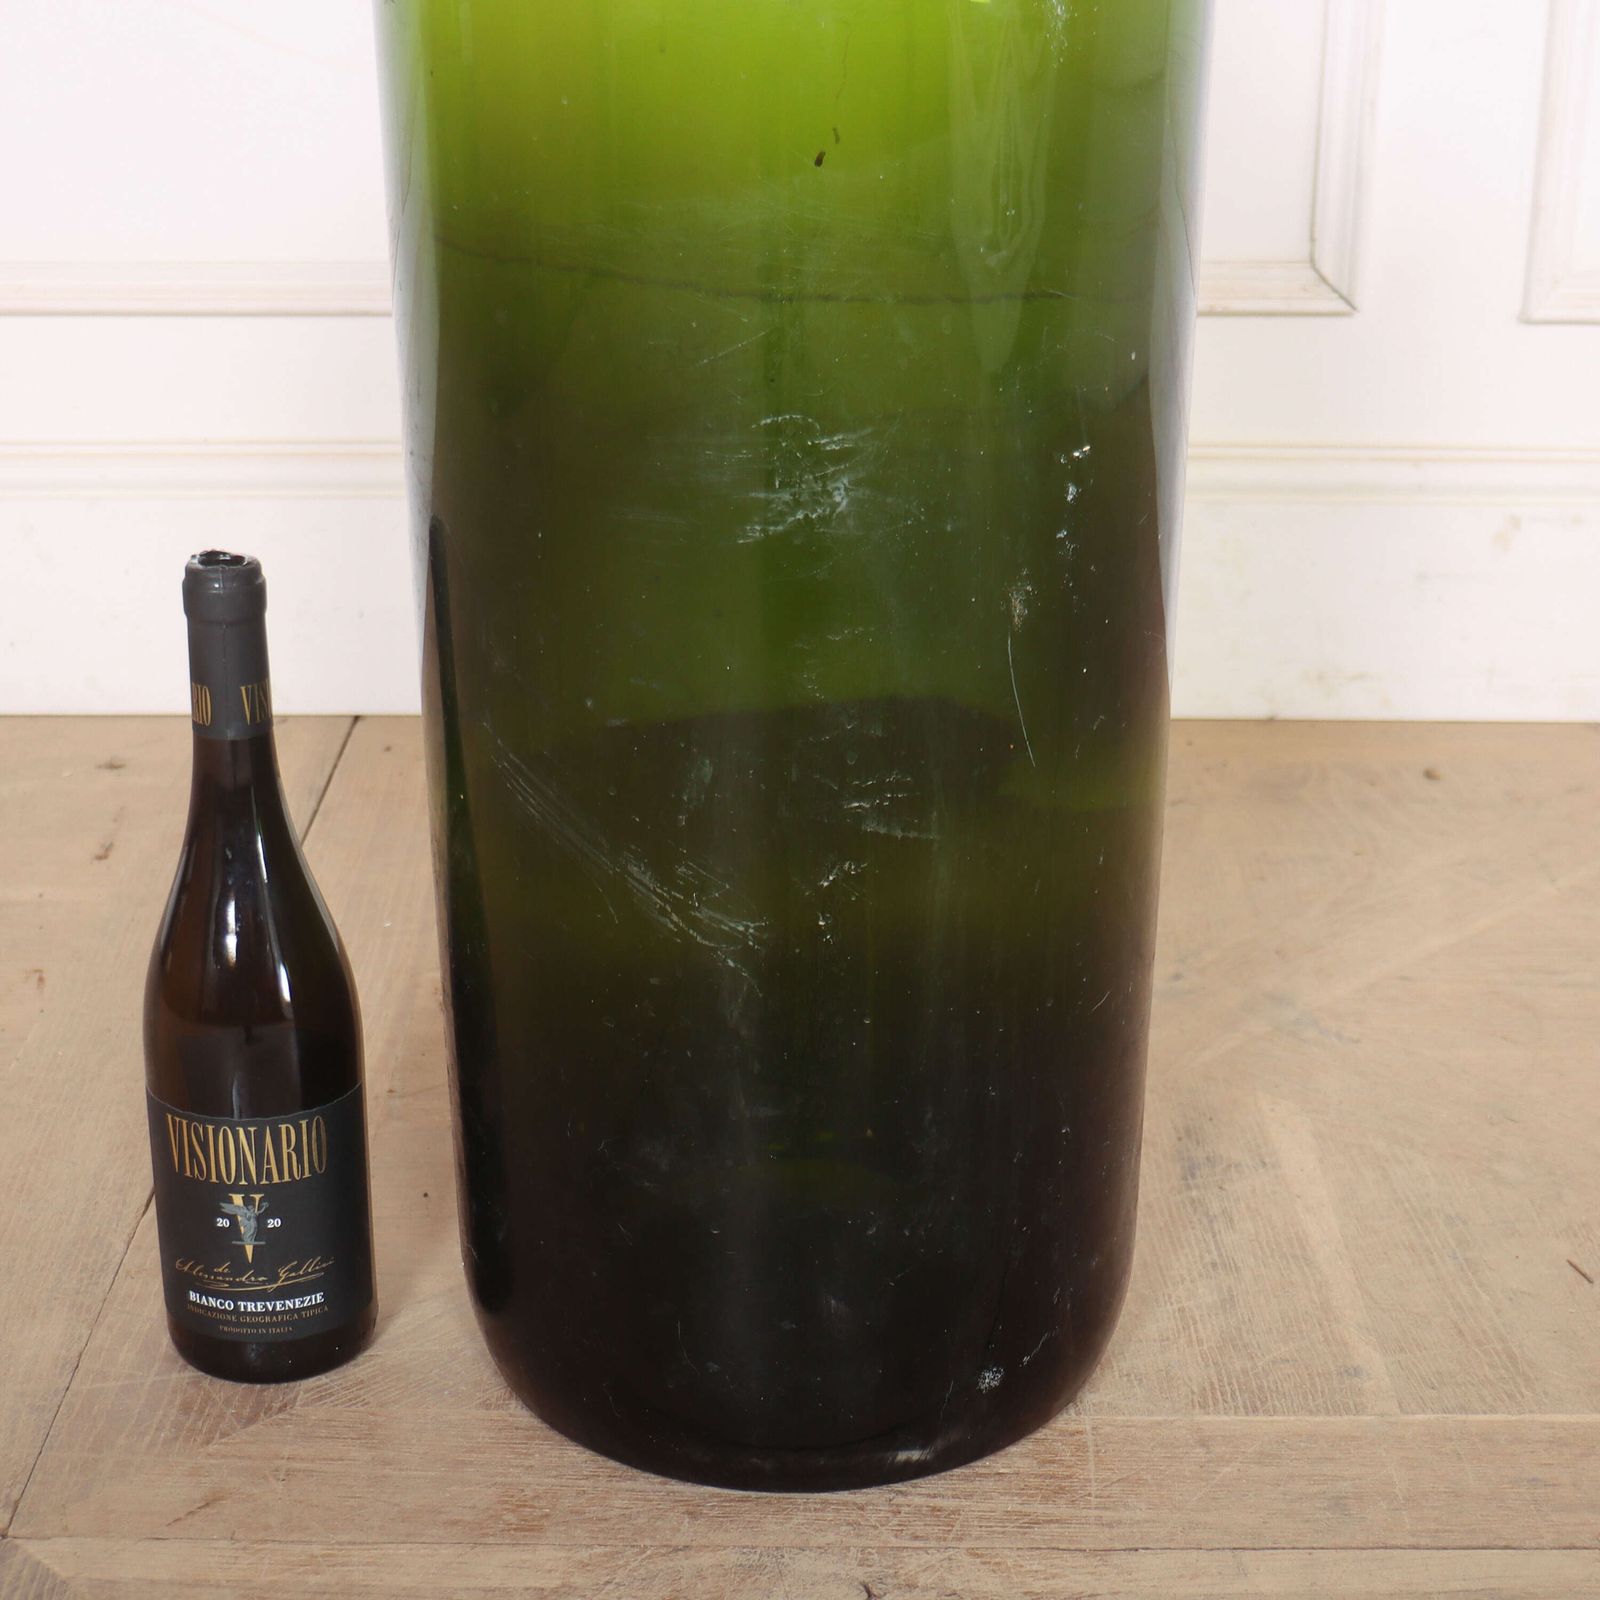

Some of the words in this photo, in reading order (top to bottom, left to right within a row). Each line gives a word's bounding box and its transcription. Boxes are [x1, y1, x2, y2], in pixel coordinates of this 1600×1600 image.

[166, 1113, 328, 1186] VISIONARIO
[216, 1217, 230, 1228] 20
[267, 1218, 281, 1228] 20
[188, 1290, 235, 1311] BIANCO
[237, 1291, 325, 1313] TREVENEZIE
[187, 1303, 238, 1323] INDICAZIONE
[239, 1312, 299, 1324] GEOGRAFICA
[301, 1305, 329, 1318] TIPICA
